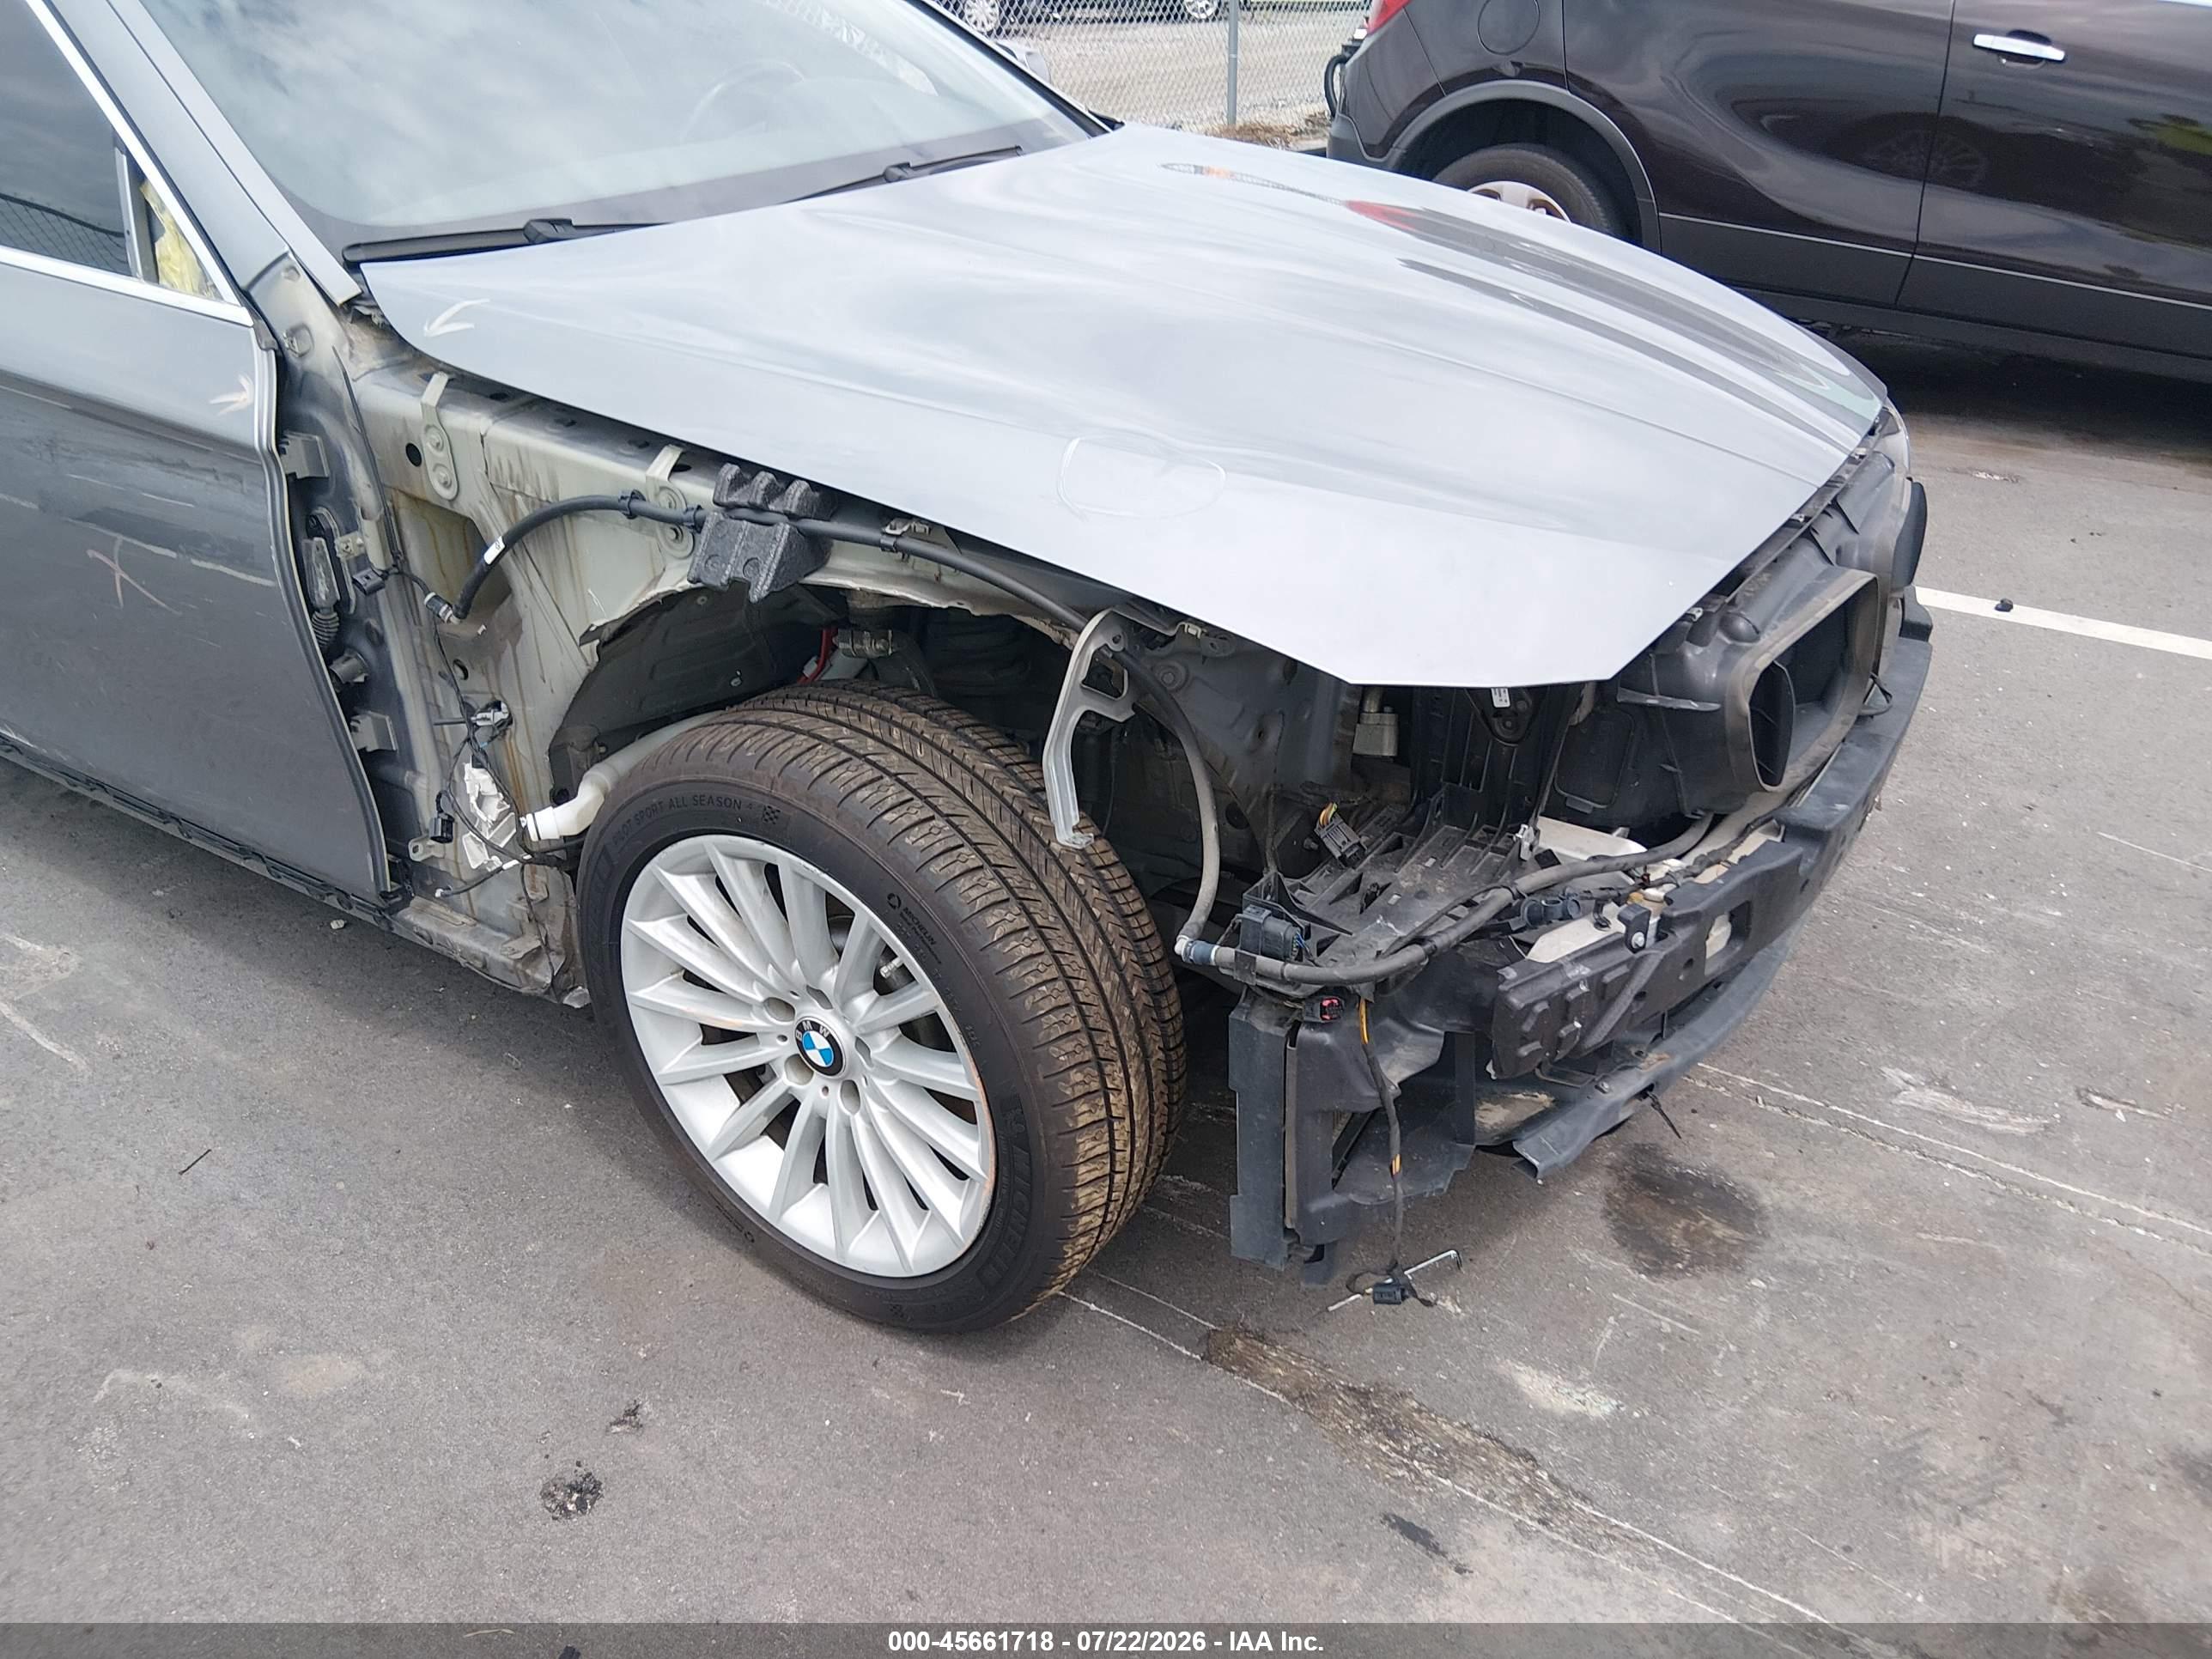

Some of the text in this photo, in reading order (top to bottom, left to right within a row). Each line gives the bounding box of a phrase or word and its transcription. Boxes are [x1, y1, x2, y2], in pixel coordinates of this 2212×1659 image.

[633, 800, 664, 826] SPORT
[668, 796, 688, 810] ALL
[692, 794, 742, 811] SEASON
[902, 906, 937, 946] MICHELIN
[795, 1020, 830, 1042] BMW
